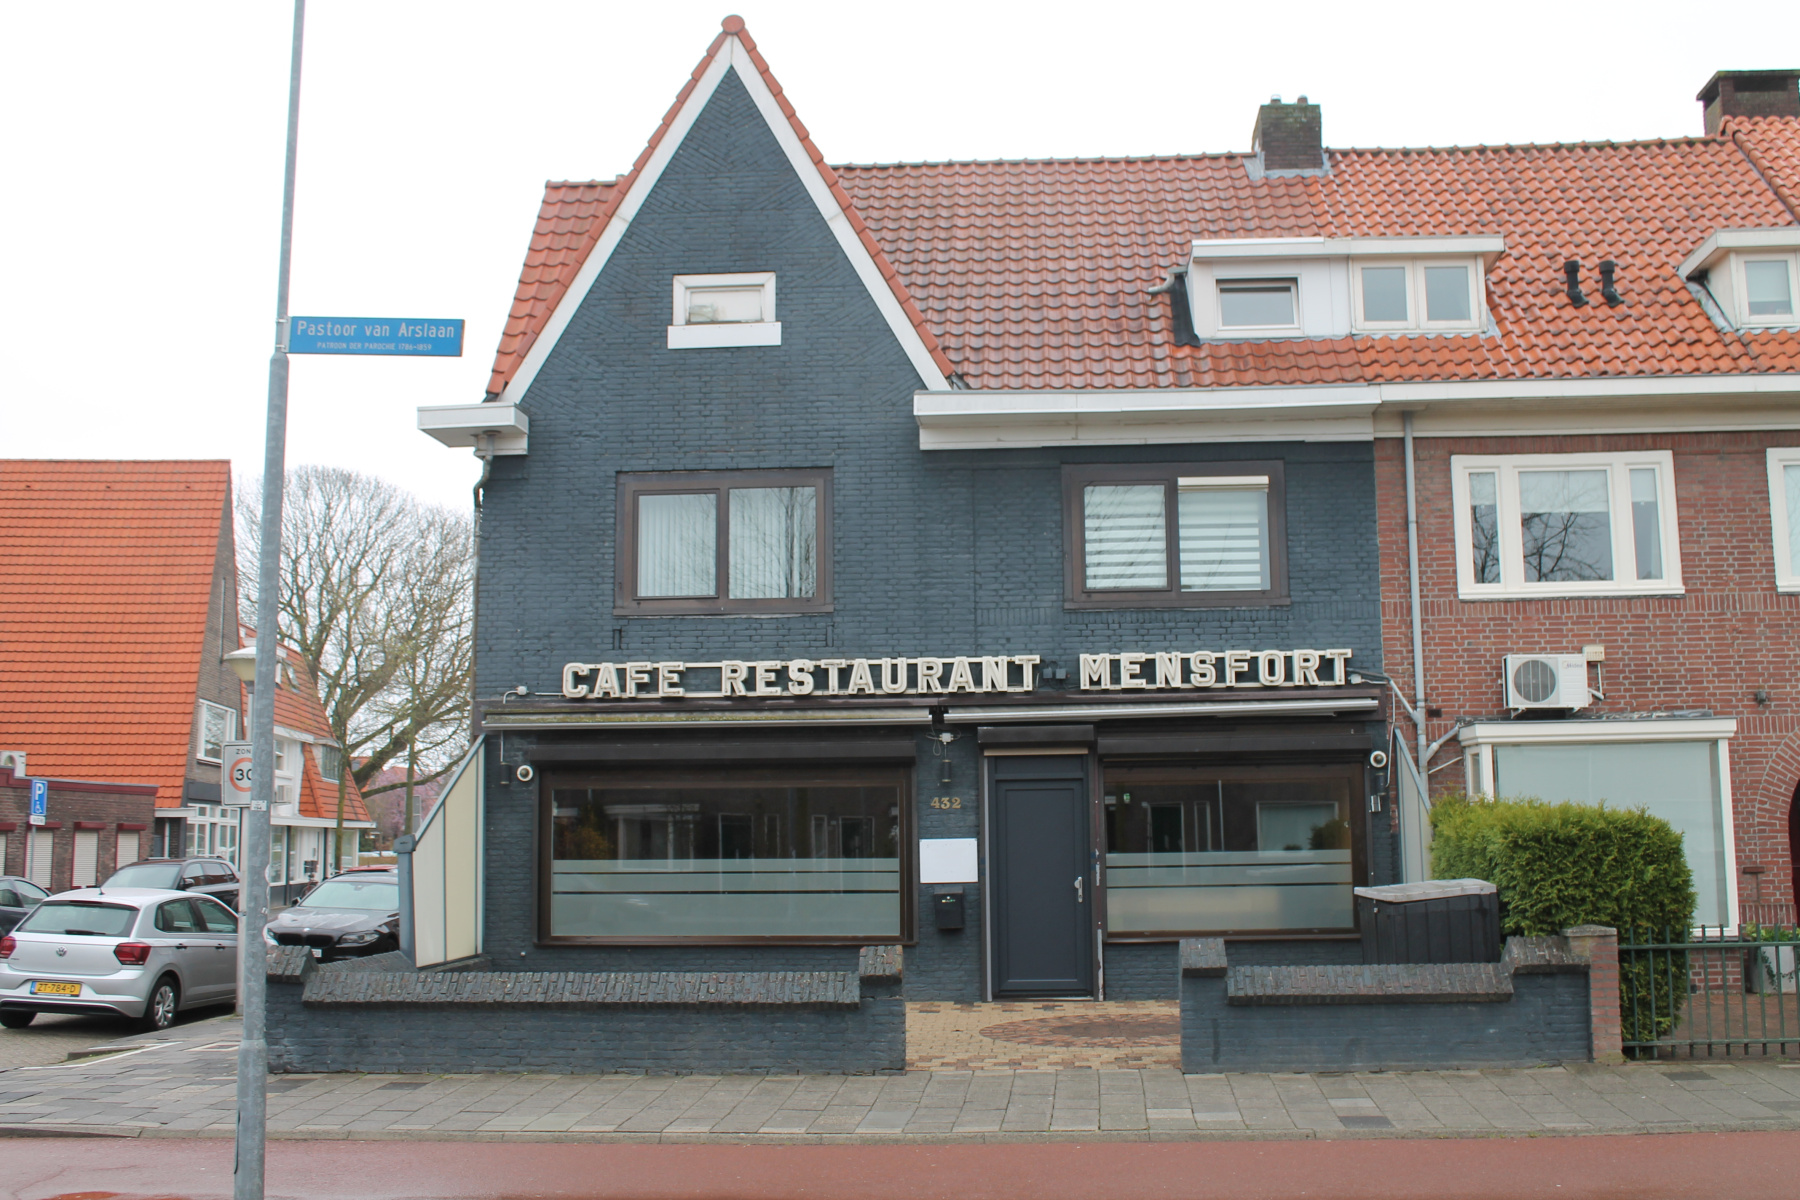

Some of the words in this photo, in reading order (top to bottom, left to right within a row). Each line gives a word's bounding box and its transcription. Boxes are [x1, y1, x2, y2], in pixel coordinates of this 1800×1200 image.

[296, 320, 357, 336] Pastoor
[364, 324, 390, 337] van
[398, 322, 454, 338] Arslaan
[317, 341, 346, 350] PATROON
[349, 342, 361, 350] DER
[364, 342, 395, 351] PAROCHIE
[562, 661, 686, 698] CAFE
[721, 654, 1041, 696] RESTAURANT
[1079, 648, 1352, 690] MENSFORT
[35, 782, 44, 801] P
[930, 796, 962, 809] 432
[37, 983, 76, 993] ZT-784-D
